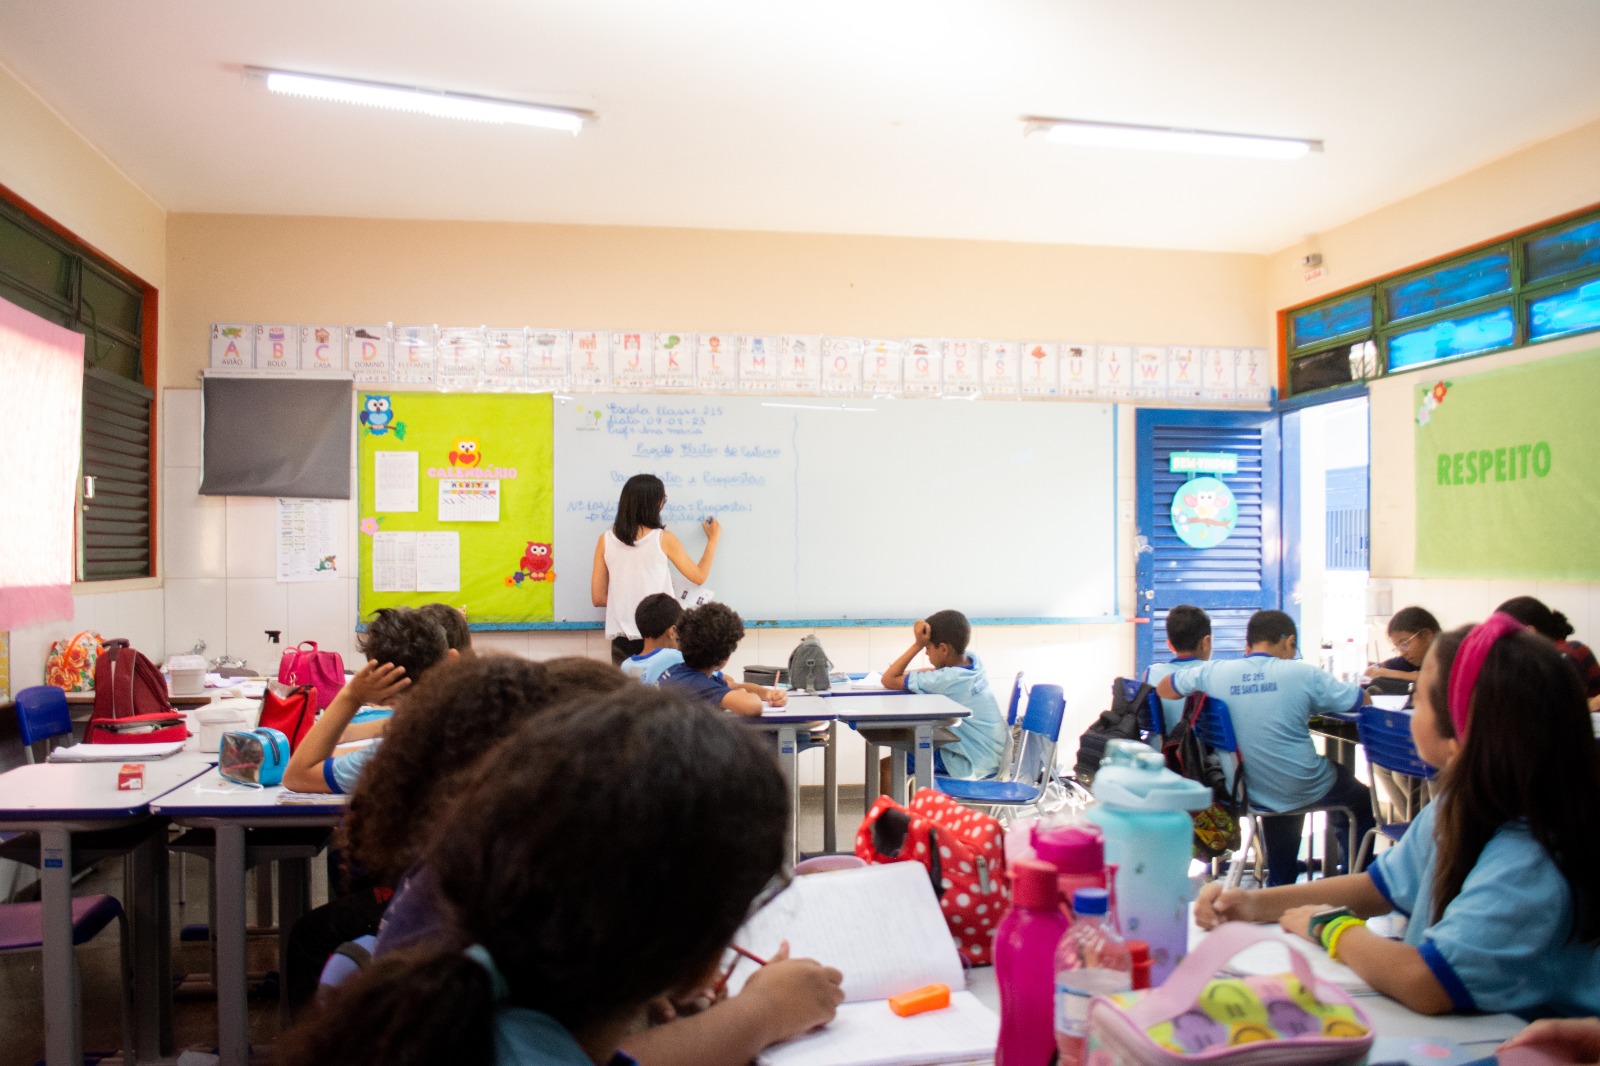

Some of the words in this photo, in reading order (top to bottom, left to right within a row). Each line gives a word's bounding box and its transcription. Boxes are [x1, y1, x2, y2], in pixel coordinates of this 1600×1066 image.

[224, 340, 240, 358] A
[273, 341, 285, 359] B
[315, 344, 330, 361] C
[361, 341, 377, 361] D
[408, 345, 420, 362] E
[453, 346, 465, 363] F
[221, 357, 243, 366] AVIÃO
[498, 353, 512, 366] G
[541, 350, 553, 366] H
[585, 351, 595, 366] I
[628, 351, 640, 368] J
[668, 351, 680, 367] K
[711, 354, 720, 369] L
[752, 355, 765, 369] M
[794, 356, 805, 370] N
[834, 356, 848, 372] O
[876, 357, 887, 374] P
[915, 357, 929, 373] Q
[956, 360, 965, 375] R
[995, 360, 1005, 375] S
[1034, 360, 1043, 377] T
[1070, 360, 1082, 376] U
[1108, 364, 1121, 379] V
[1141, 364, 1159, 378] W
[1179, 363, 1189, 378] X
[1214, 367, 1223, 382] Y
[1247, 367, 1256, 381] Z
[1436, 441, 1552, 486] RESPEITO
[427, 464, 519, 479] CALENDÁRIO
[1242, 673, 1251, 682] EC
[1230, 685, 1241, 695] CRE
[1242, 683, 1259, 694] SANTA
[1260, 681, 1278, 692] MARIA
